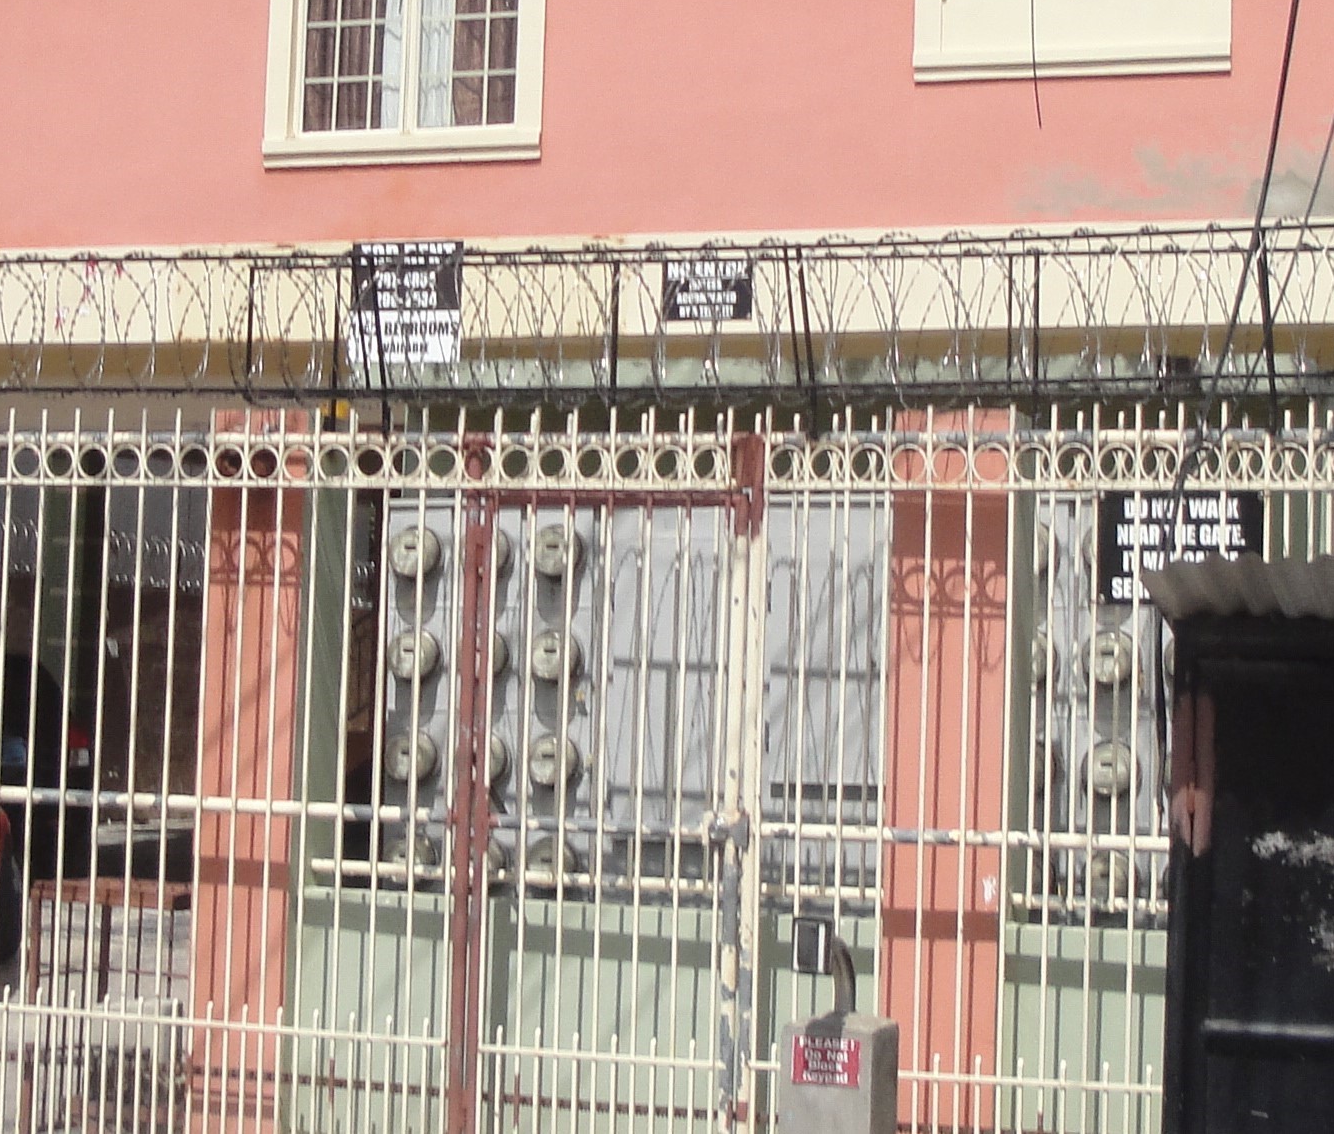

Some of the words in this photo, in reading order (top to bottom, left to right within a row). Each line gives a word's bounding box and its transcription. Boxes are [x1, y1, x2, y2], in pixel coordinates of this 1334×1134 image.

[378, 343, 427, 354] VAILABLE
[1152, 497, 1187, 519] NO
[1189, 497, 1239, 519] WAK
[805, 1048, 821, 1061] Do
[808, 1060, 843, 1073] Block
[802, 1070, 848, 1085] Keypad
